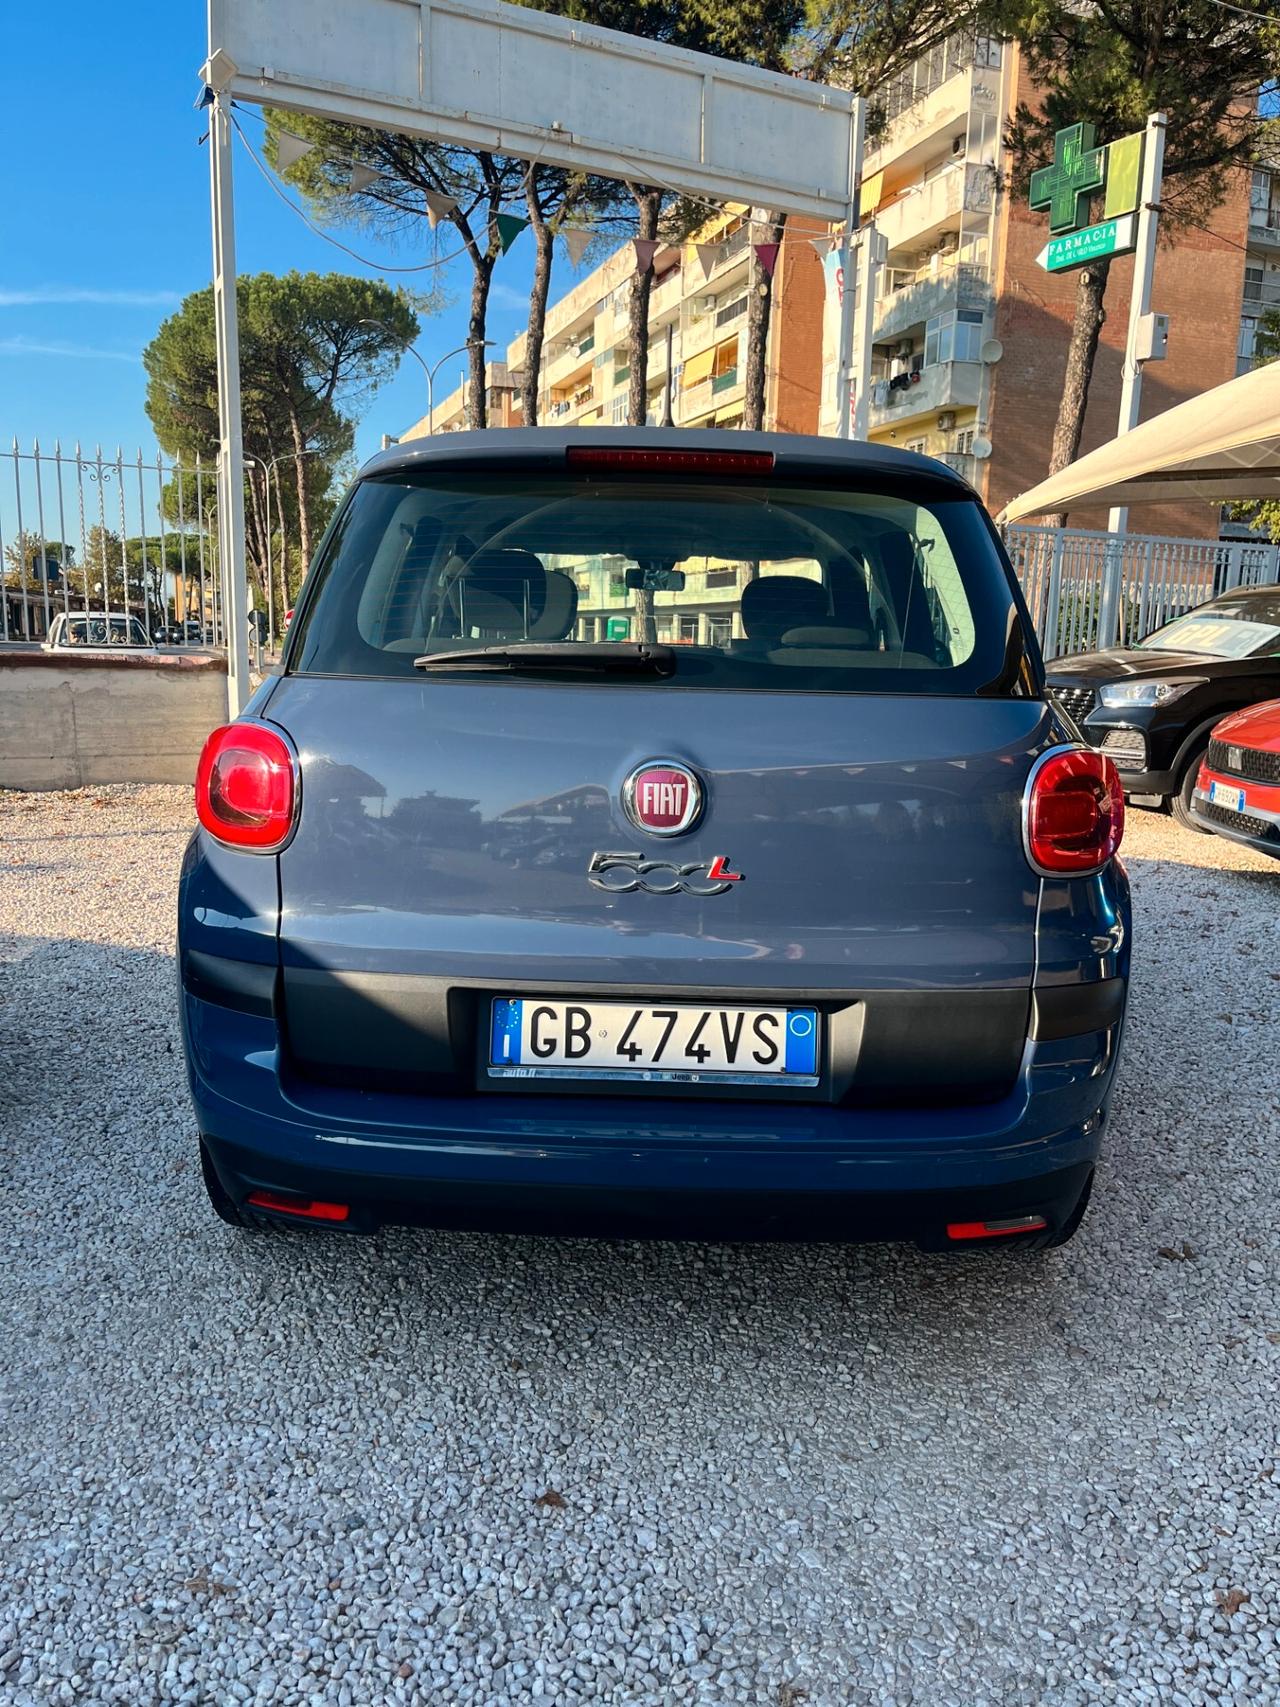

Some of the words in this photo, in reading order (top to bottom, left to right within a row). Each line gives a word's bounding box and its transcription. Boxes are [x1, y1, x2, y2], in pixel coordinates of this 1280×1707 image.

[1049, 225, 1116, 256] FARMACIA
[643, 783, 685, 816] FIAT
[530, 1006, 592, 1059] GB
[616, 1009, 779, 1065] 474VS
